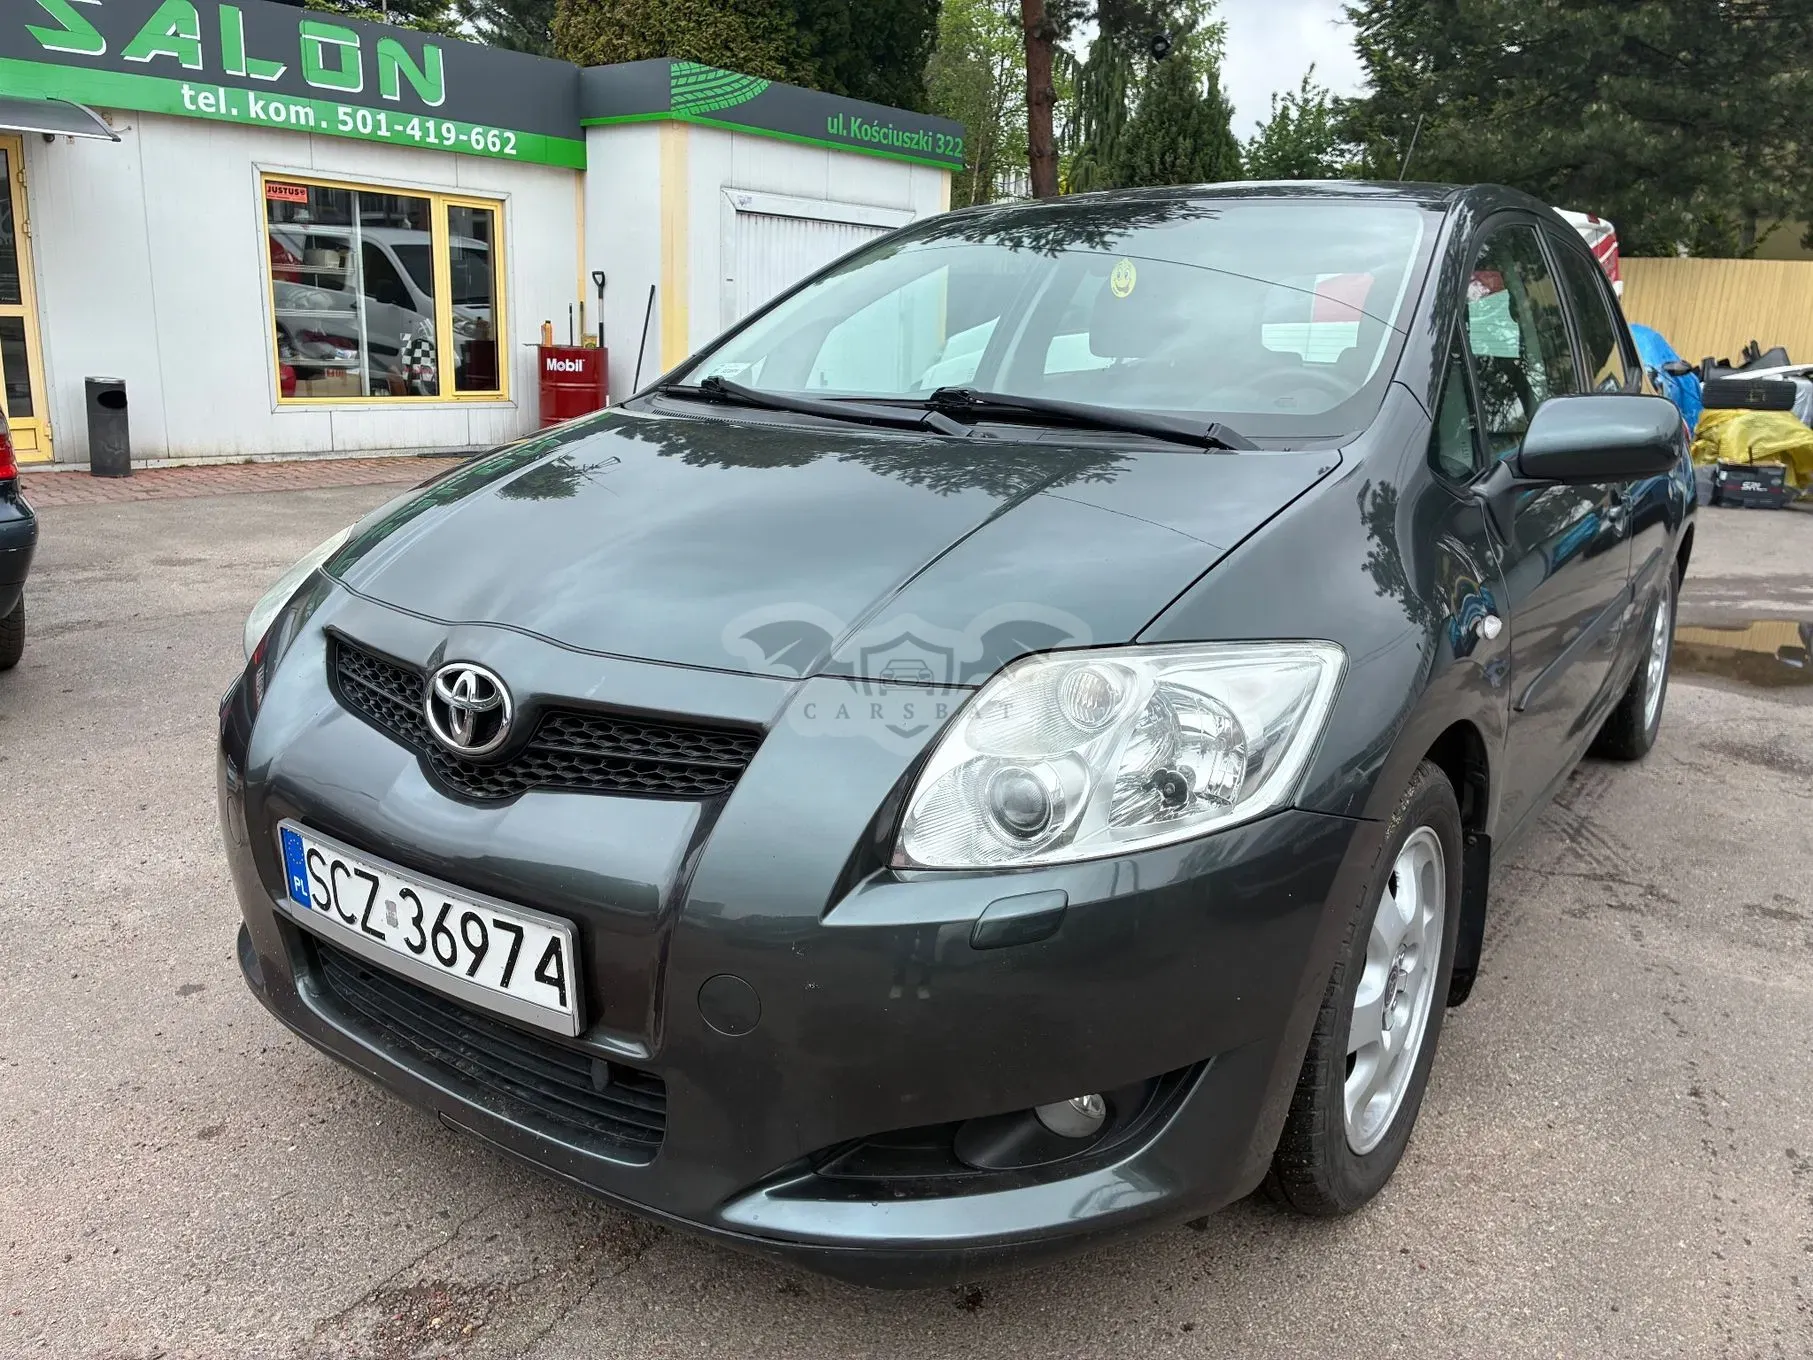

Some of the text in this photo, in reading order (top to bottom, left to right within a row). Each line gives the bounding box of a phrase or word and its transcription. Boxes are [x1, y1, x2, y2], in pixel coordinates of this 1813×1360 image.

[25, 0, 446, 107] SALON
[181, 84, 517, 154] tel. kom. 501-419-662
[827, 113, 963, 158] ul. Kościuszki 322
[267, 185, 300, 196] JUSTUS
[546, 358, 583, 372] Mobil
[293, 876, 307, 896] PL
[306, 847, 567, 1008] SCZ 36974
